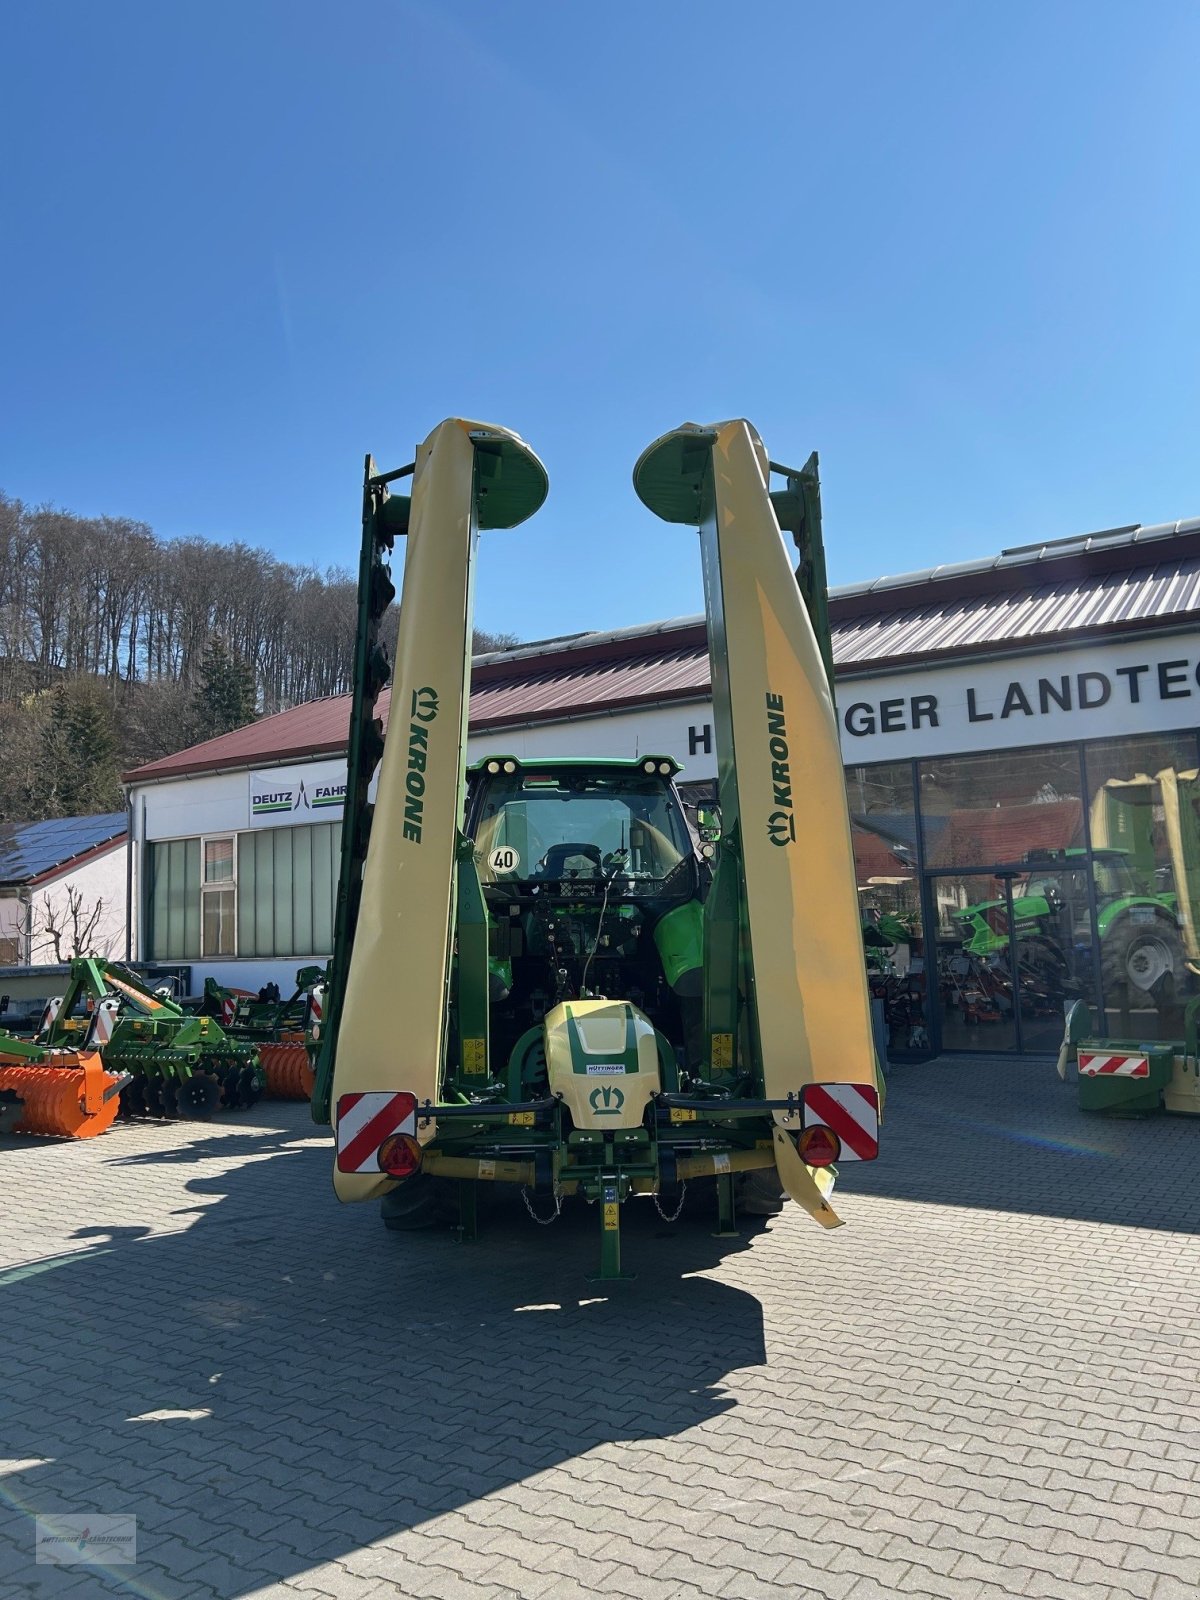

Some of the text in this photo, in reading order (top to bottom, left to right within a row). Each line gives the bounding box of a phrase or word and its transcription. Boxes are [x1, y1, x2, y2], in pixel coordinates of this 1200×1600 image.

[966, 659, 1200, 723] LANDTE
[765, 692, 793, 809] KRONE
[252, 785, 347, 804] DEUTZ FAHR
[402, 722, 429, 845] KRONE
[494, 851, 513, 868] 40
